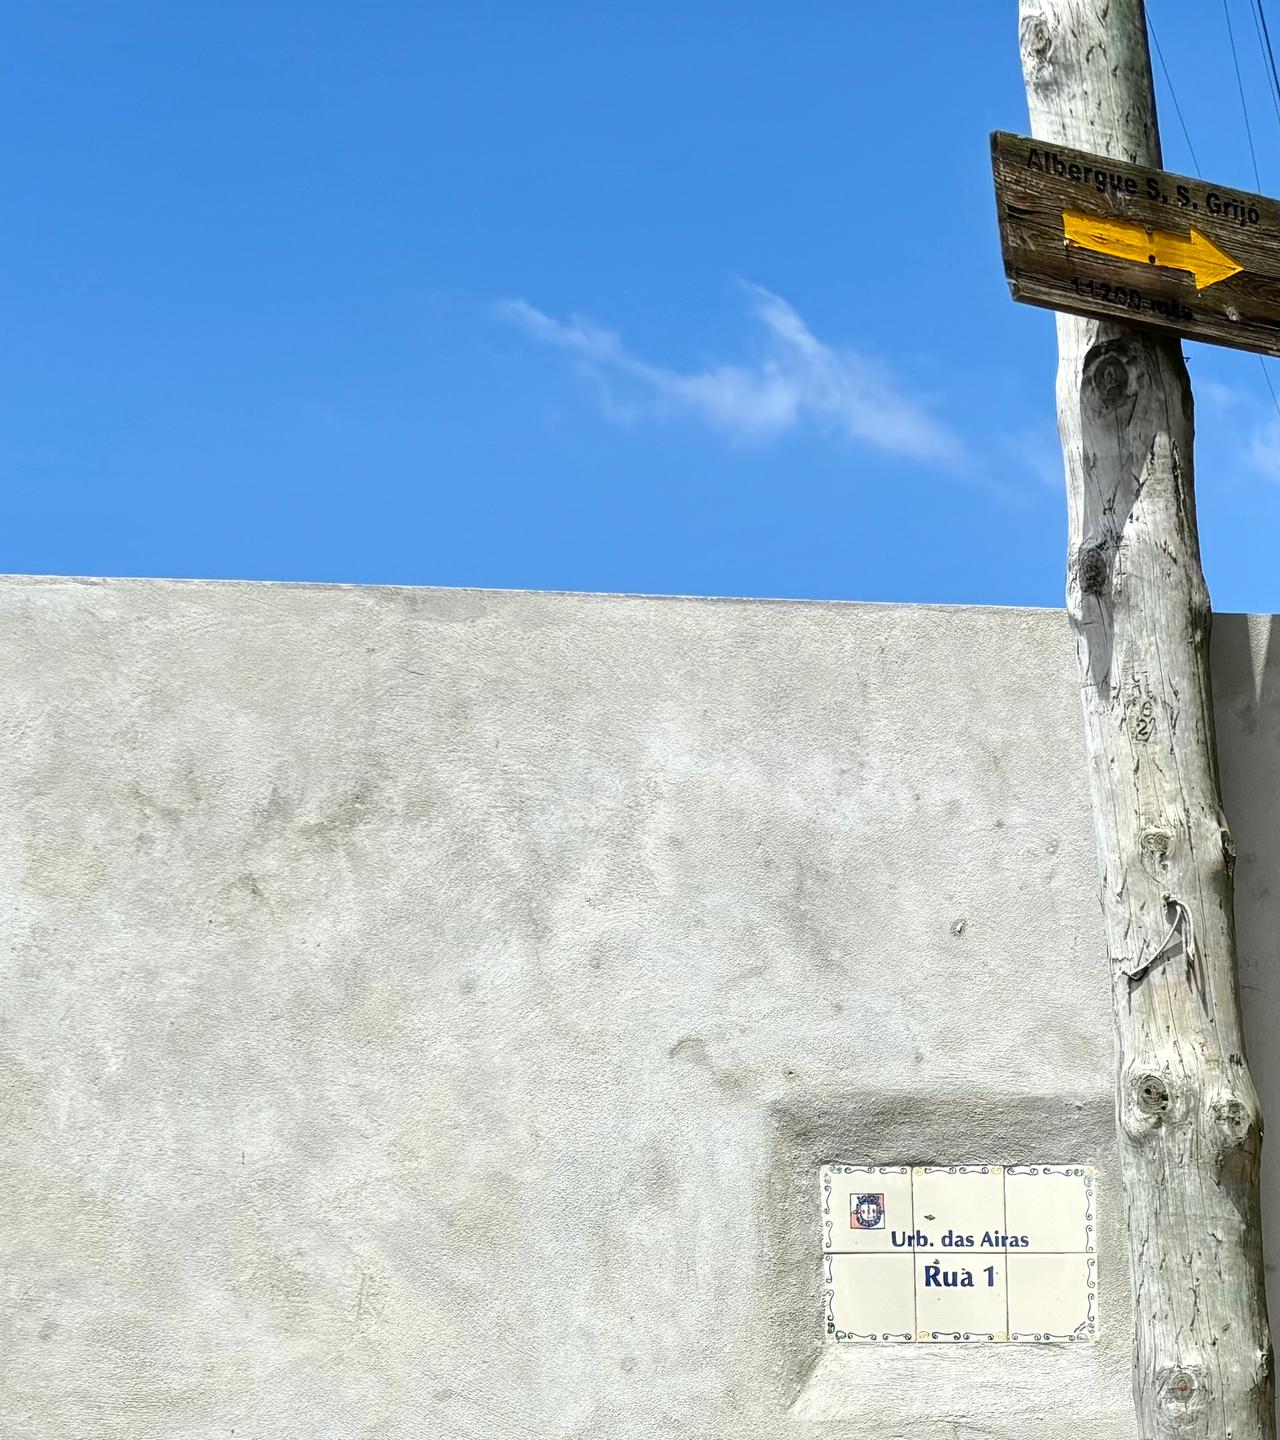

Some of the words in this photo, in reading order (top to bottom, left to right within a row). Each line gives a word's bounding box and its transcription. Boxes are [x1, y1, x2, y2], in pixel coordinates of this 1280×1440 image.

[1027, 148, 1137, 195] Albergue
[1146, 177, 1168, 203] S.
[1176, 185, 1197, 210] S.
[1206, 192, 1260, 227] Grijó
[891, 1229, 935, 1248] Urb.
[941, 1229, 974, 1248] das
[980, 1230, 1030, 1248] Airas
[924, 1264, 975, 1288] Rua
[983, 1265, 995, 1288] 1
